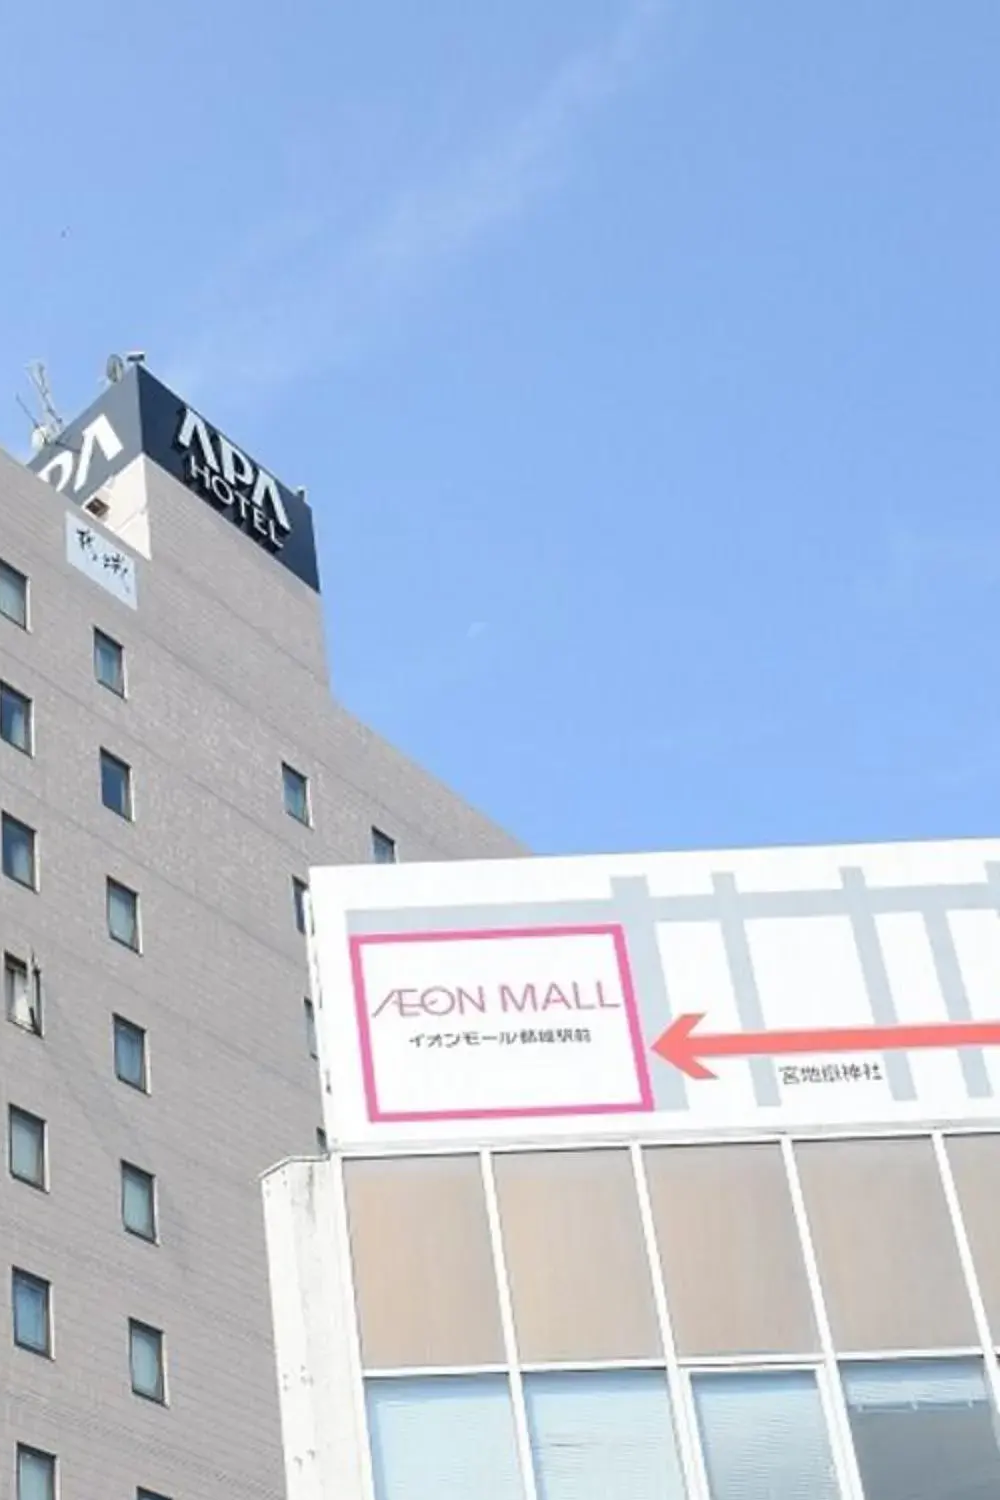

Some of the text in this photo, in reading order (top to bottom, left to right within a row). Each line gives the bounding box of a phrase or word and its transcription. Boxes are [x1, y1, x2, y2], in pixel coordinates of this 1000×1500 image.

[177, 406, 291, 532] APA
[190, 454, 284, 550] HOTEL
[500, 980, 621, 1012] MALL
